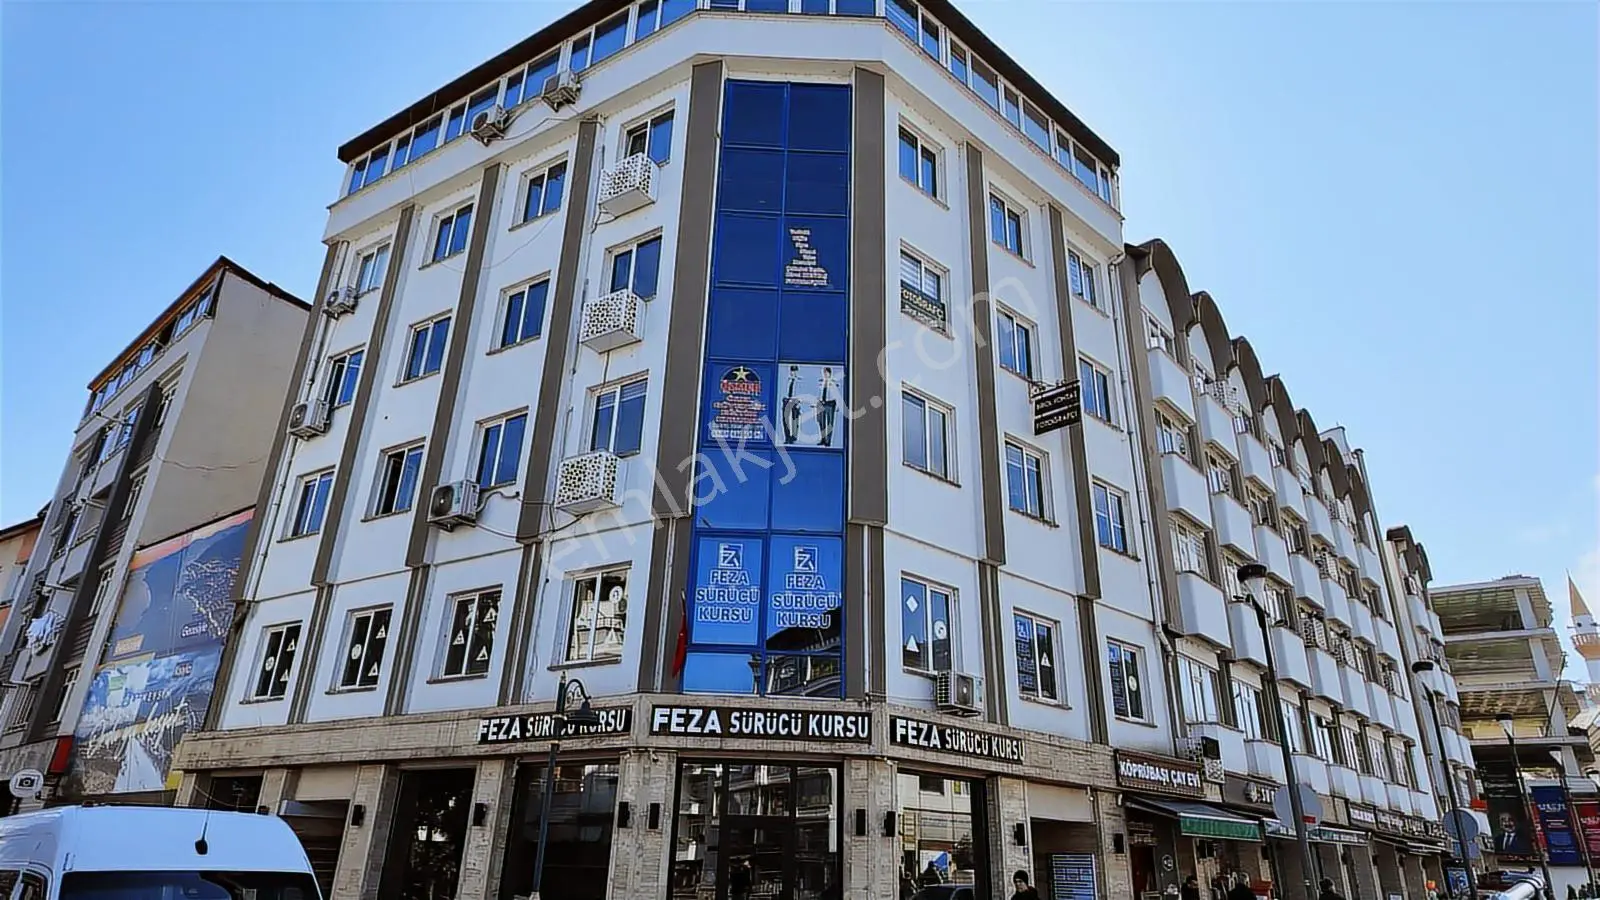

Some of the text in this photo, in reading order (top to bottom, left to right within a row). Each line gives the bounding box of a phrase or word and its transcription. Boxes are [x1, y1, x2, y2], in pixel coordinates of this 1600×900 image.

[710, 570, 749, 585] FEZA
[785, 574, 826, 590] FEZA
[696, 585, 761, 604] SÜRÜCÜ
[772, 591, 839, 609] SÜRÜCÜ
[698, 605, 753, 622] KURSU
[776, 612, 832, 629] KURSU
[477, 716, 521, 742] FEZA
[652, 708, 869, 738] FEZA SÜRÜCÜ KURSU
[896, 718, 1026, 761] FEZA SÜRÜCÜ KURSU
[1119, 758, 1170, 787] KÖPRÜBAŞI
[1170, 769, 1187, 788] ÇAY
